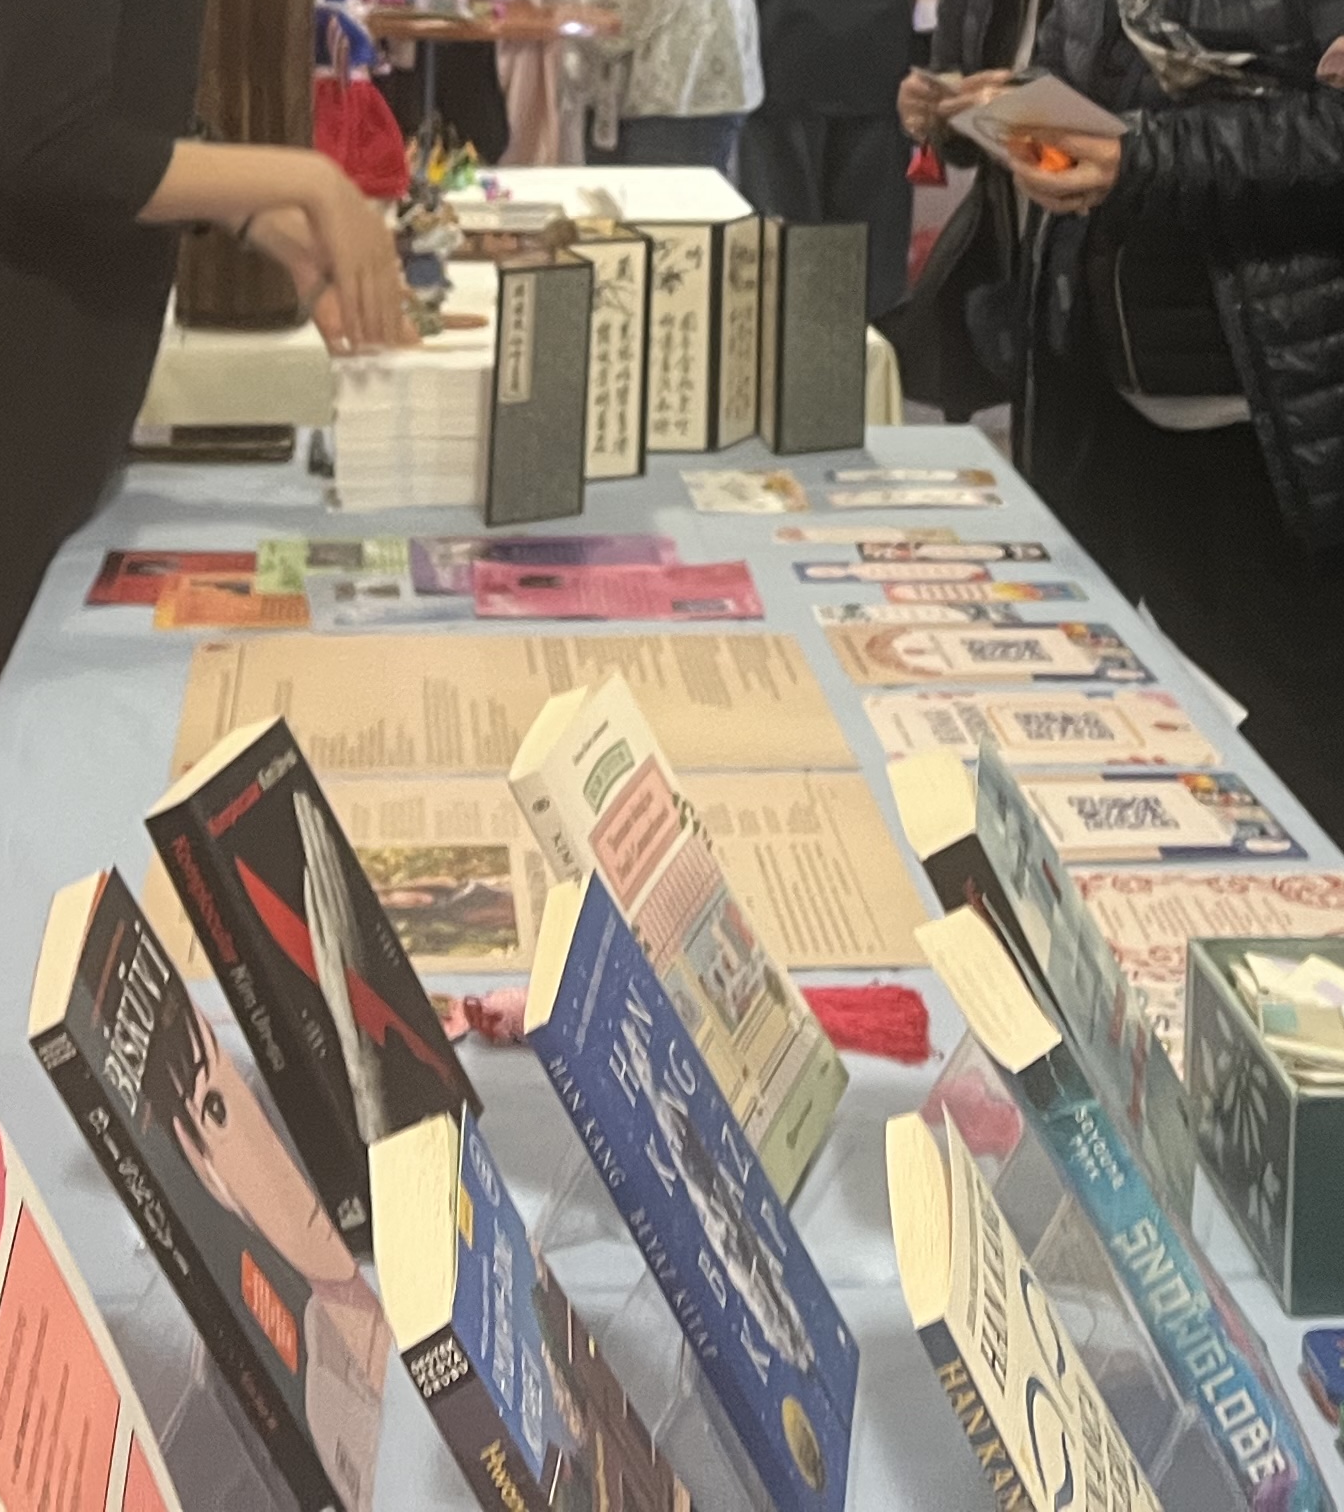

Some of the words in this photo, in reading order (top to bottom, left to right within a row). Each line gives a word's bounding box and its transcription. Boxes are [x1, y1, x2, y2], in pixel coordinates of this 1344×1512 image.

[549, 1055, 586, 1112] HAN
[584, 1116, 626, 1188] KANG
[936, 1355, 991, 1437] HAN
[1110, 1215, 1289, 1485] SNOWGLOBE
